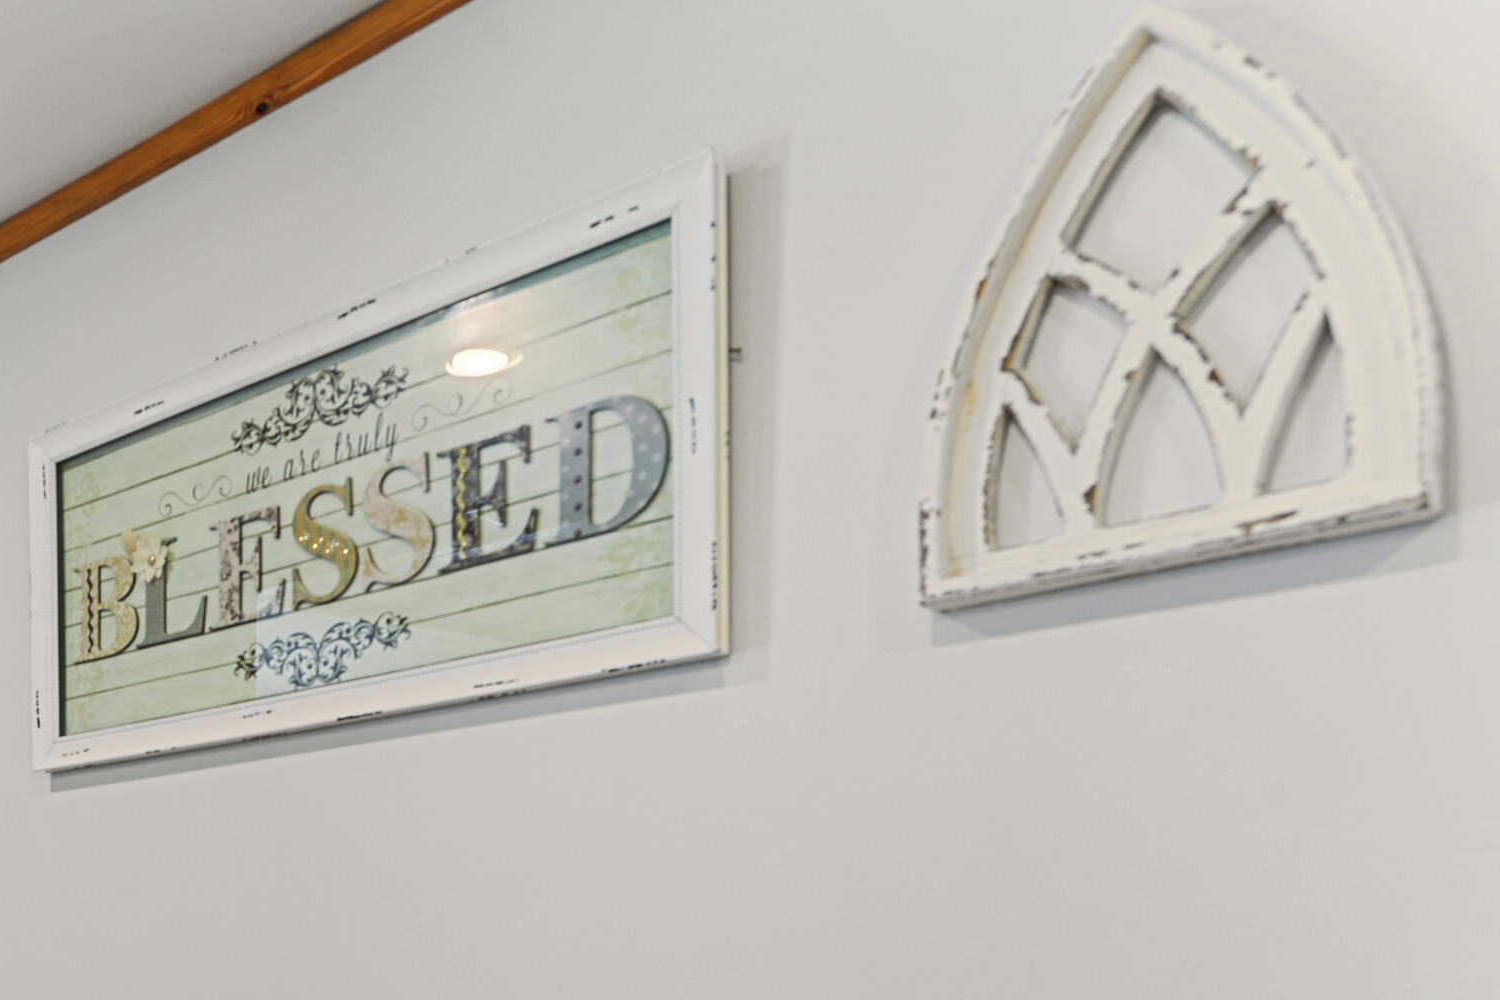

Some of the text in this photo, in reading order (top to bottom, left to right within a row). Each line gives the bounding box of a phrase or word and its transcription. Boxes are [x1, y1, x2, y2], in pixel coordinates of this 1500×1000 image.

[72, 394, 670, 665] BLESSED
[246, 411, 398, 495] we are truly
